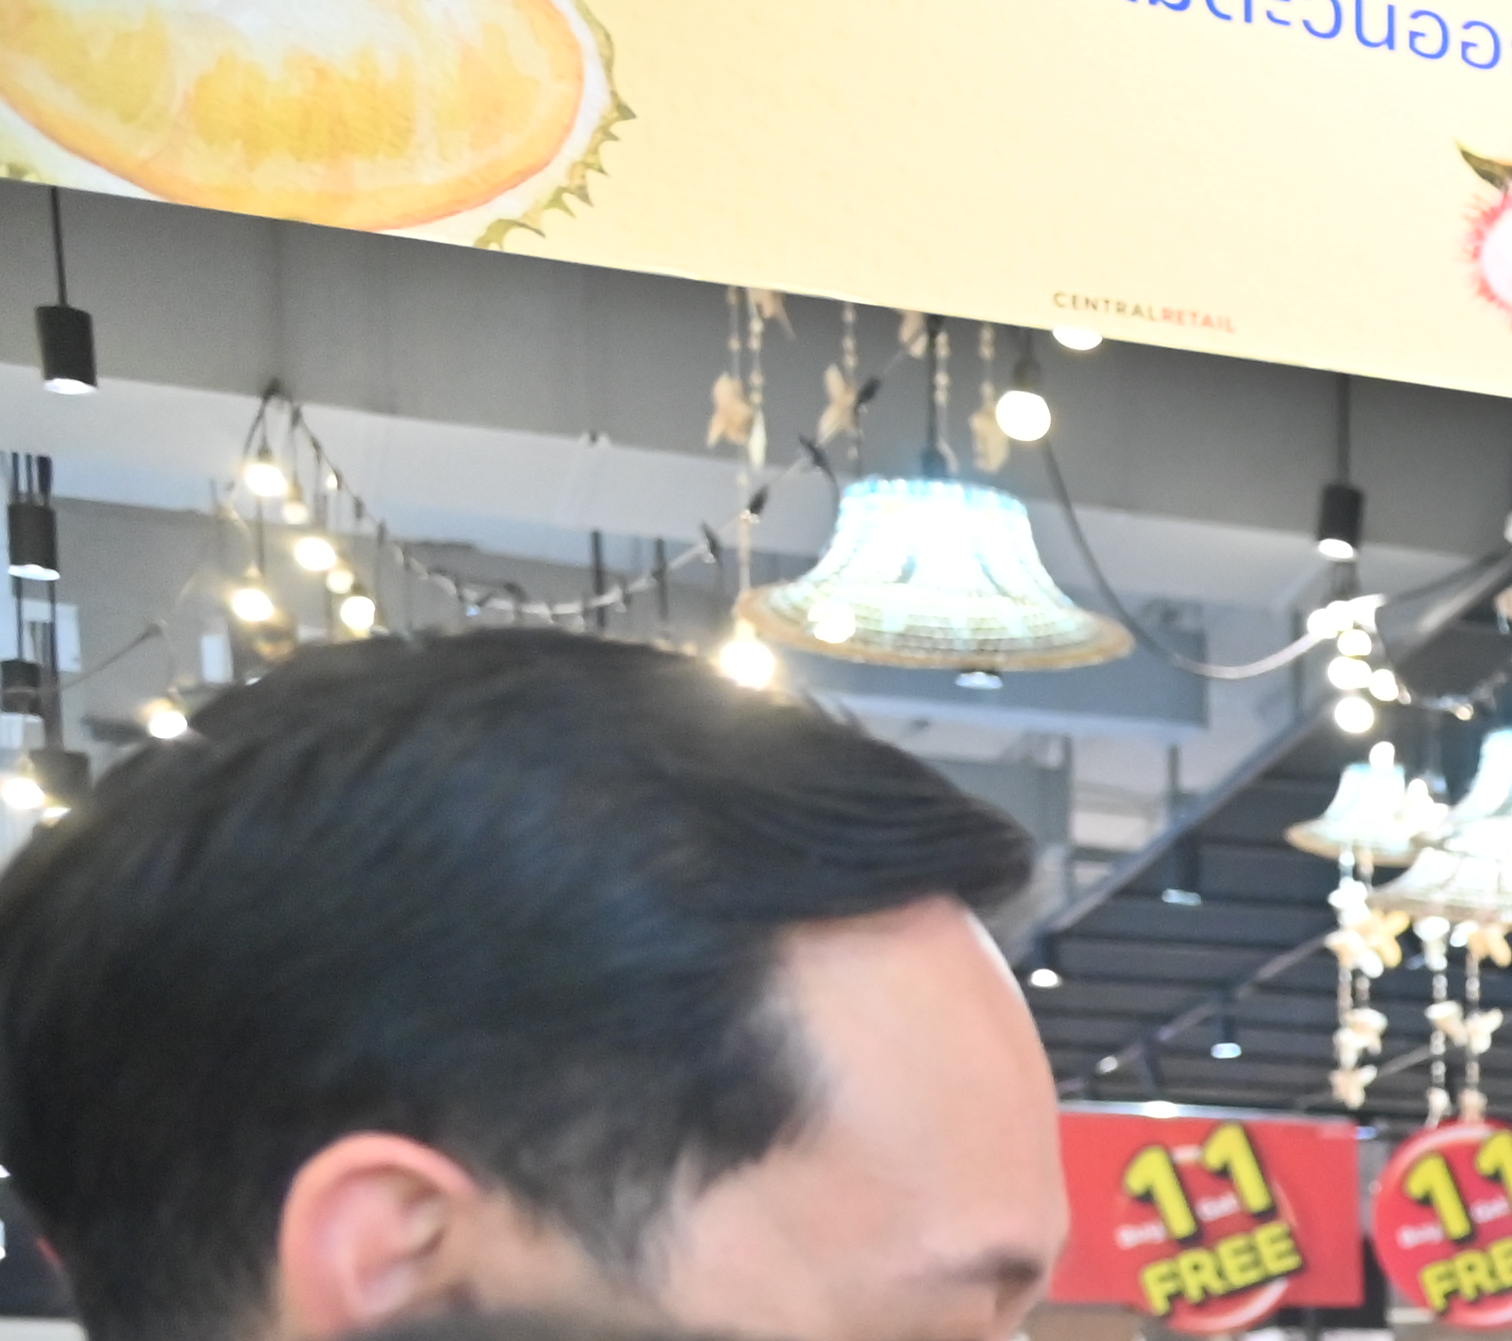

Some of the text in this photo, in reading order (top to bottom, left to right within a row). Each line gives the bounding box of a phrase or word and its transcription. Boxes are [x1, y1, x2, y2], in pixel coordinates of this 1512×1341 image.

[1123, 1119, 1275, 1241] 1 1
[1405, 1151, 1473, 1241] 1
[1138, 1221, 1302, 1317] FREE
